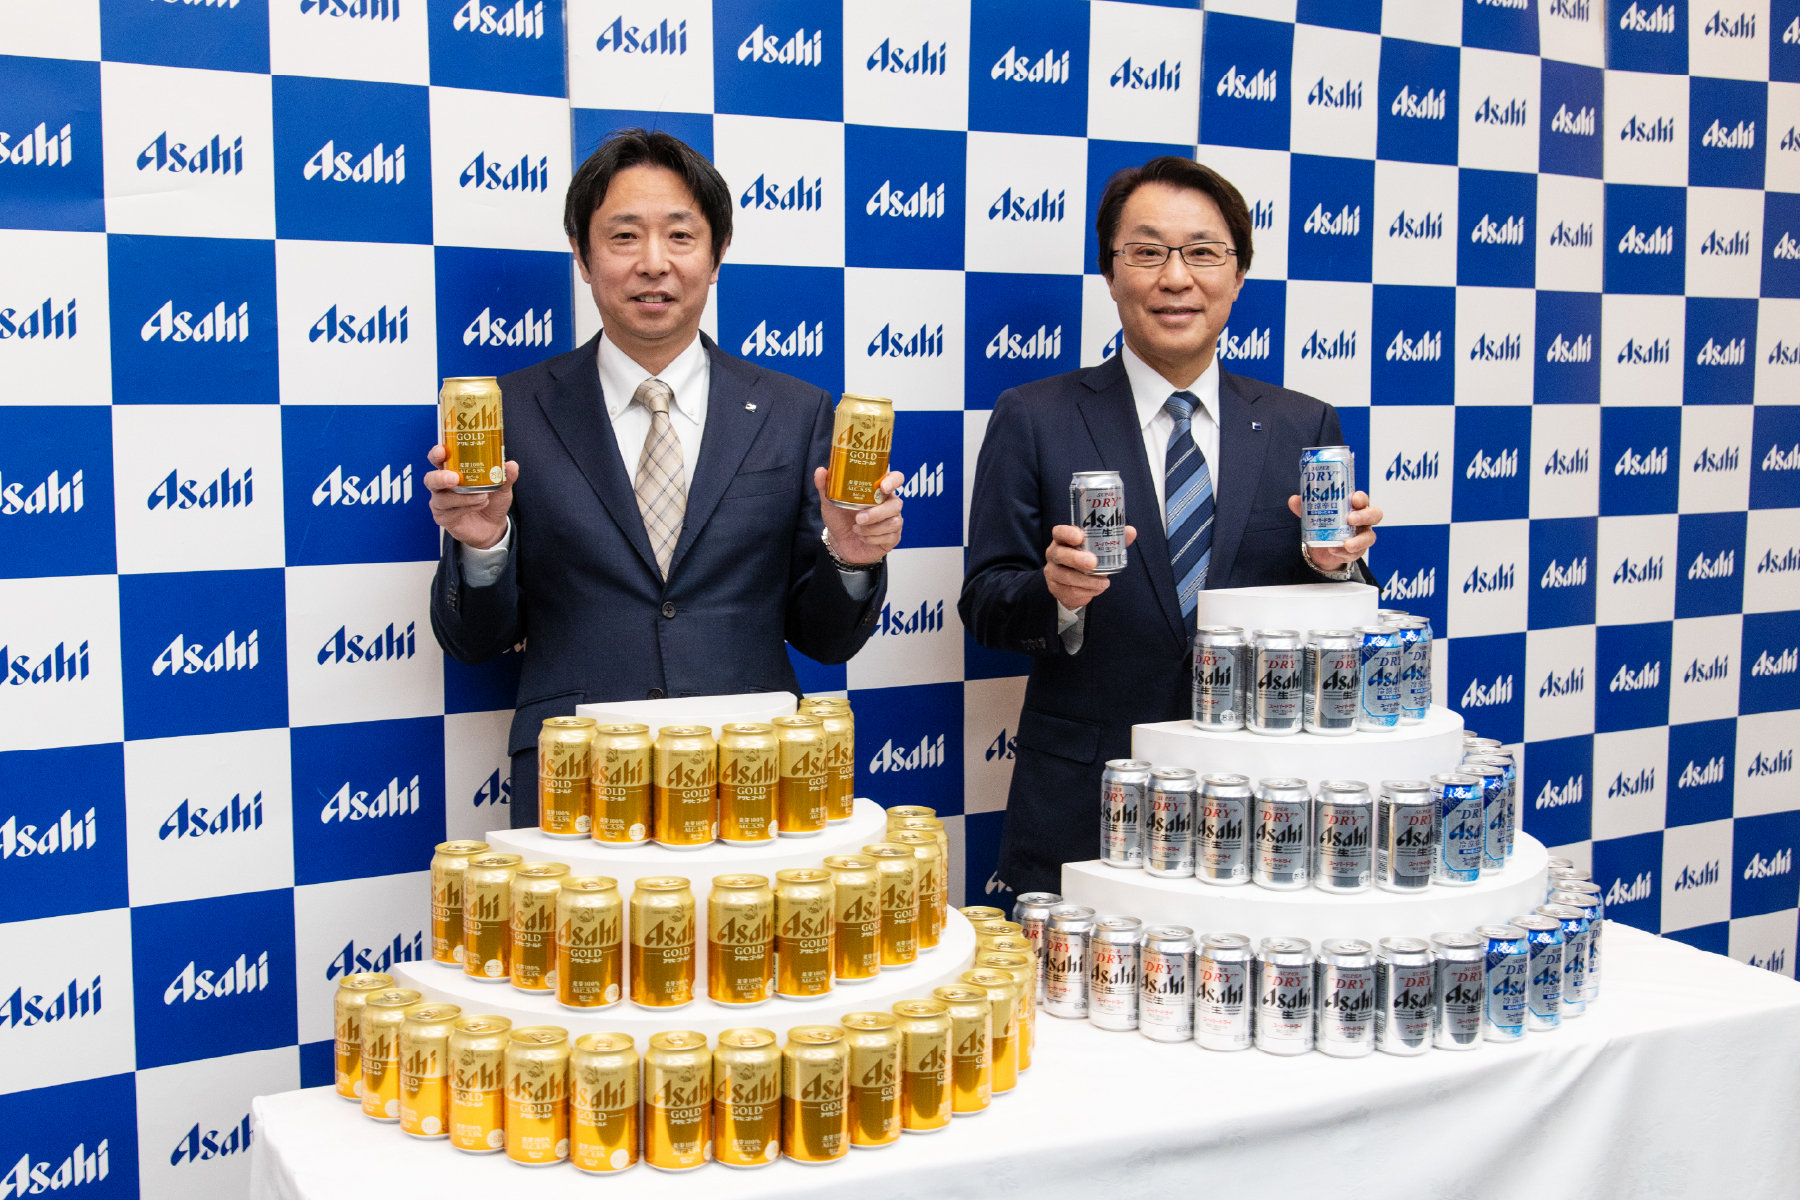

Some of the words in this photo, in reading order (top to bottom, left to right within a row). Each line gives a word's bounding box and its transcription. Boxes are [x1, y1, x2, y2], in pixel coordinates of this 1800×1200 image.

[453, 0, 543, 39] Asahi
[1620, 2, 1674, 33] Asahi
[1705, 12, 1754, 37] Asahi
[597, 17, 686, 54] Asahi
[738, 24, 821, 66] Asahi
[867, 39, 945, 74] Asahi
[991, 46, 1069, 83] Asahi
[1110, 58, 1180, 90] Asahi
[1217, 66, 1276, 101] Asahi
[1308, 78, 1361, 107] Asahi
[1392, 86, 1445, 119] Asahi
[1475, 98, 1525, 124] Asahi
[1552, 104, 1594, 135] Asahi
[1621, 117, 1673, 141] Asahi
[1702, 119, 1754, 148] Asahi
[0, 122, 71, 166] sahi
[137, 132, 242, 174] Asahi
[303, 140, 405, 184] Asahi
[460, 152, 547, 191] Asahi
[741, 174, 821, 210] Asahi
[866, 180, 944, 217] Asahi
[989, 188, 1064, 221] Asahi
[1304, 203, 1359, 235] Asahi
[1390, 212, 1441, 238] Asahi
[1472, 215, 1524, 244] Asahi
[1551, 223, 1592, 246] Asahi
[1619, 226, 1672, 253] Asahi
[1702, 232, 1748, 254] Asahi
[0, 298, 76, 338] sahi
[141, 300, 248, 342] Asahi
[309, 305, 407, 343] Asahi
[463, 308, 552, 346] Asahi
[741, 320, 822, 356] Asahi
[868, 324, 942, 357] Asahi
[986, 325, 1061, 358] Asahi
[1302, 331, 1355, 359] Asahi
[1386, 331, 1441, 361] Asahi
[1471, 335, 1520, 360] Asahi
[1547, 334, 1591, 362] Asahi
[1618, 340, 1669, 363] Asahi
[1697, 338, 1745, 365] Asahi
[444, 404, 498, 430] Asahi
[837, 424, 892, 451] Asahi
[850, 450, 878, 460] GOLD
[1386, 453, 1438, 480] Asahi
[1467, 449, 1517, 478] Asahi
[1545, 450, 1588, 474] Asahi
[1615, 448, 1667, 475] Asahi
[1694, 448, 1738, 471] Asahi
[0, 470, 83, 514] sahi
[148, 468, 252, 510] Asahi
[312, 464, 412, 506] Asahi
[1302, 481, 1345, 502] Asahi
[1464, 565, 1513, 593] Asahi
[1541, 558, 1586, 588] Asahi
[1614, 557, 1662, 583] Asahi
[1689, 550, 1734, 579] Asahi
[1382, 568, 1435, 600] Asahi
[152, 630, 258, 676] Asahi
[318, 622, 415, 665] Asahi
[1610, 662, 1659, 691] Asahi
[1684, 658, 1727, 682] Asahi
[1752, 648, 1797, 676] Asahi
[1462, 675, 1512, 708] Asahi
[1540, 669, 1583, 697] Asahi
[870, 735, 943, 773] Asahi
[1748, 750, 1792, 776] Asahi
[722, 755, 777, 784] Asahi
[1609, 769, 1654, 798] Asahi
[1679, 757, 1724, 788] Asahi
[545, 780, 572, 789] GOLD
[598, 787, 626, 796] GOLD
[683, 788, 710, 798] GOLD
[737, 786, 766, 795] GOLD
[1536, 776, 1582, 809] Asahi
[321, 776, 419, 823] Asahi
[159, 792, 262, 840] Asahi
[1146, 812, 1191, 832] Asahi
[1197, 819, 1242, 839] Asahi
[1256, 822, 1302, 844] Asahi
[1319, 825, 1368, 847] Asahi
[1675, 862, 1718, 890] Asahi
[1744, 849, 1791, 879] Asahi
[1605, 872, 1650, 906] Asahi
[515, 932, 541, 942] GOLD
[558, 916, 618, 946] Asahi
[800, 938, 828, 948] GOLD
[570, 948, 602, 958] GOLD
[663, 947, 690, 958] GOLD
[735, 945, 764, 955] GOLD
[164, 952, 268, 1004] Asahi
[1091, 963, 1135, 984] Asahi
[1141, 972, 1184, 995] Asahi
[1196, 982, 1244, 1005] Asahi
[1262, 987, 1310, 1009] Asahi
[1324, 989, 1373, 1011] Asahi
[455, 1091, 483, 1101] GOLD
[716, 1071, 777, 1105] Asahi
[520, 1104, 552, 1112] GOLD
[577, 1112, 607, 1120] GOLD
[670, 1107, 702, 1119] GOLD
[731, 1107, 763, 1115] GOLD
[171, 1114, 254, 1166] Asah
[0, 1139, 108, 1200] Asahi
